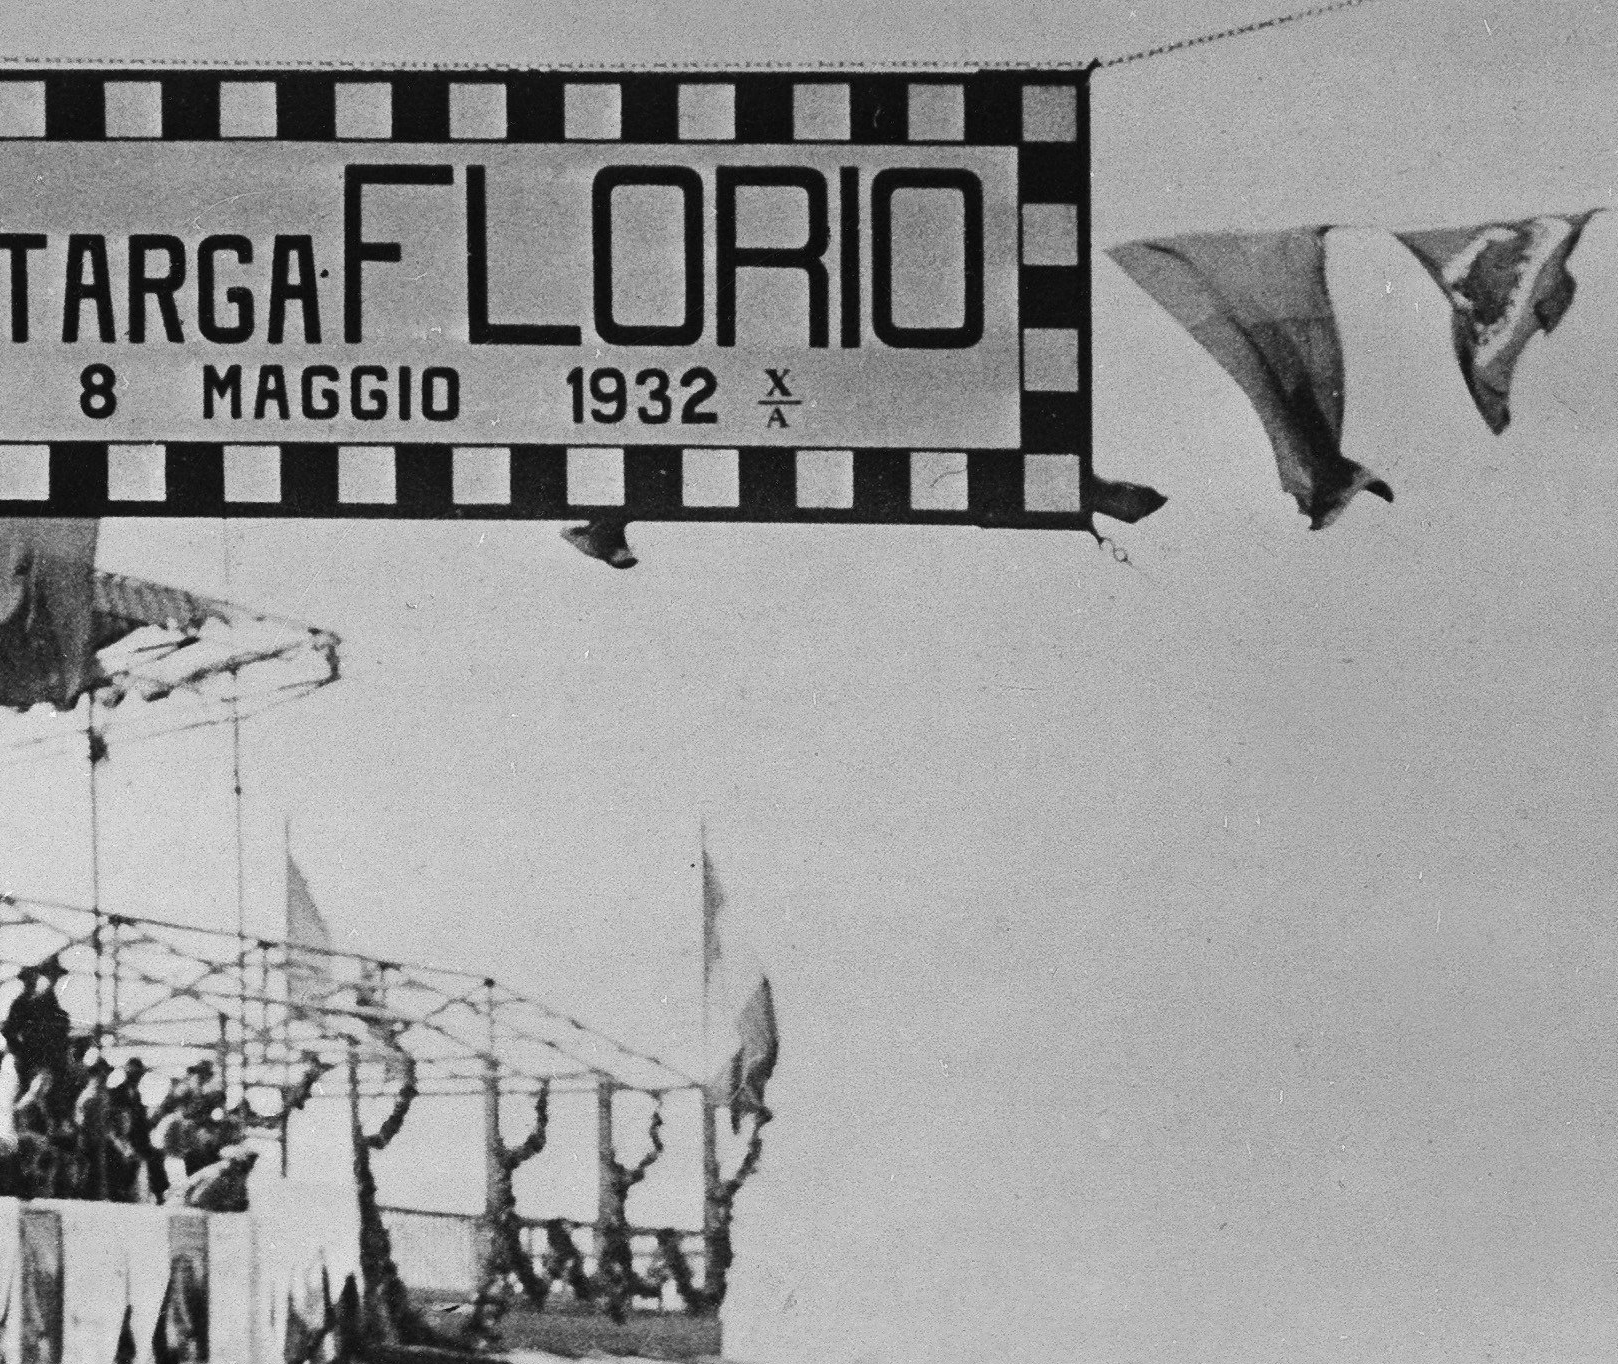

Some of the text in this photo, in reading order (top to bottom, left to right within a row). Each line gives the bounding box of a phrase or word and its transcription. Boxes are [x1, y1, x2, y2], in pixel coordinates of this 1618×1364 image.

[342, 163, 987, 351] FLORIO
[78, 363, 119, 421] 8
[202, 363, 461, 423] MAGGIO
[565, 365, 720, 426] 1932
